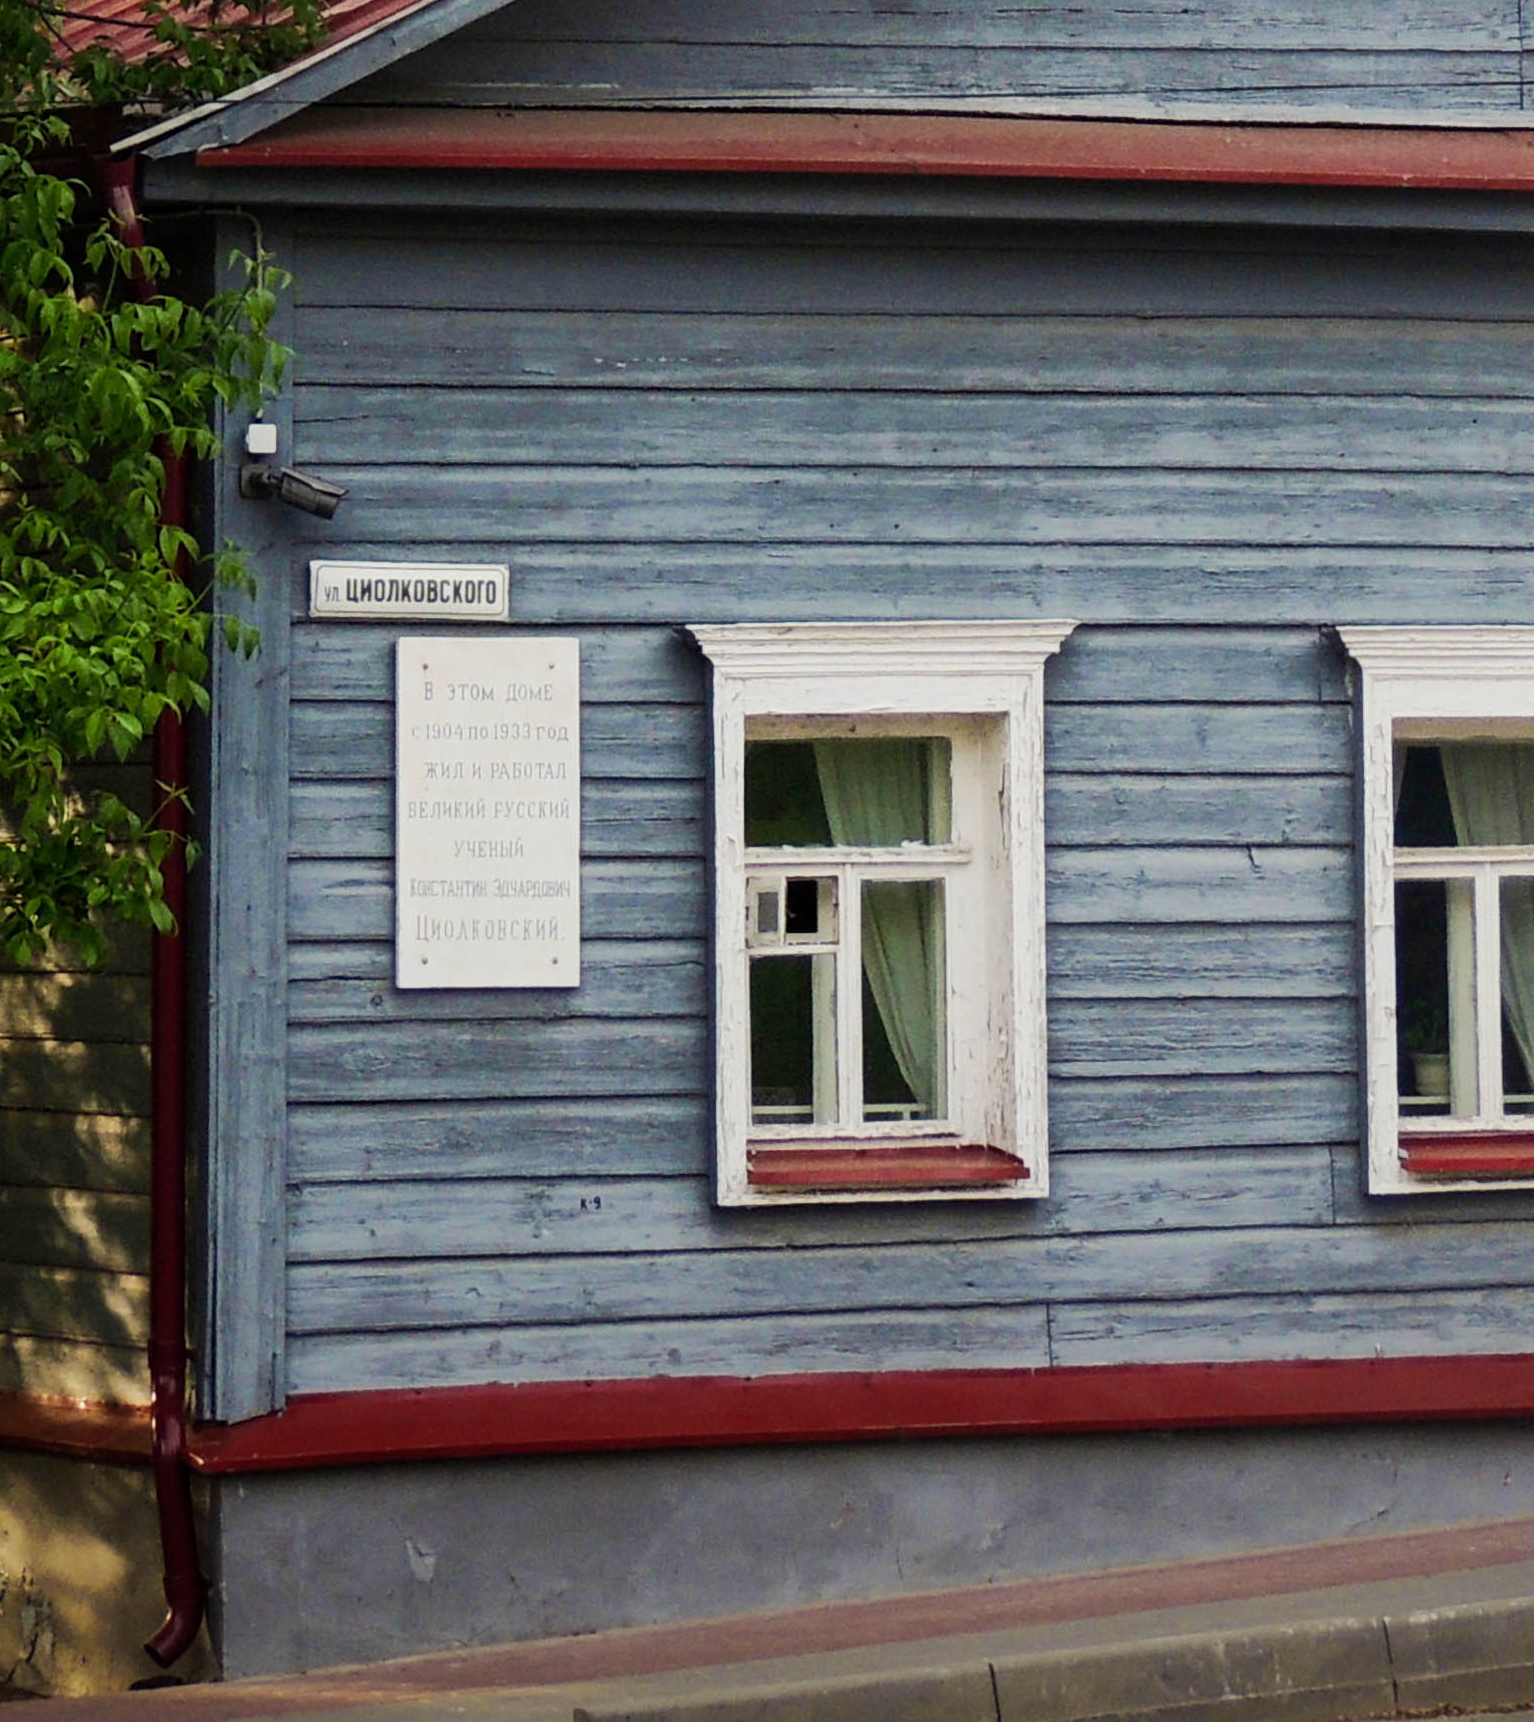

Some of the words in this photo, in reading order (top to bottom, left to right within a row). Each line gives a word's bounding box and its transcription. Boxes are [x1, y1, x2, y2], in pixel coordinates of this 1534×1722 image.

[346, 578, 497, 604] ЦИОЛКОВСКОГО
[423, 680, 434, 701] В
[446, 683, 495, 702] ЭТОМ
[505, 683, 554, 703] ДОМЕ
[426, 722, 463, 740] 1904
[494, 722, 531, 740] 1933
[424, 761, 464, 780] ЖИЛ
[471, 761, 482, 780] И
[490, 761, 567, 780] РАБОТАЛ
[408, 797, 486, 819] ВЕЛИКИЙ
[493, 797, 570, 819] РУССКИЙ
[453, 837, 524, 859] УЧЕНЫЙ
